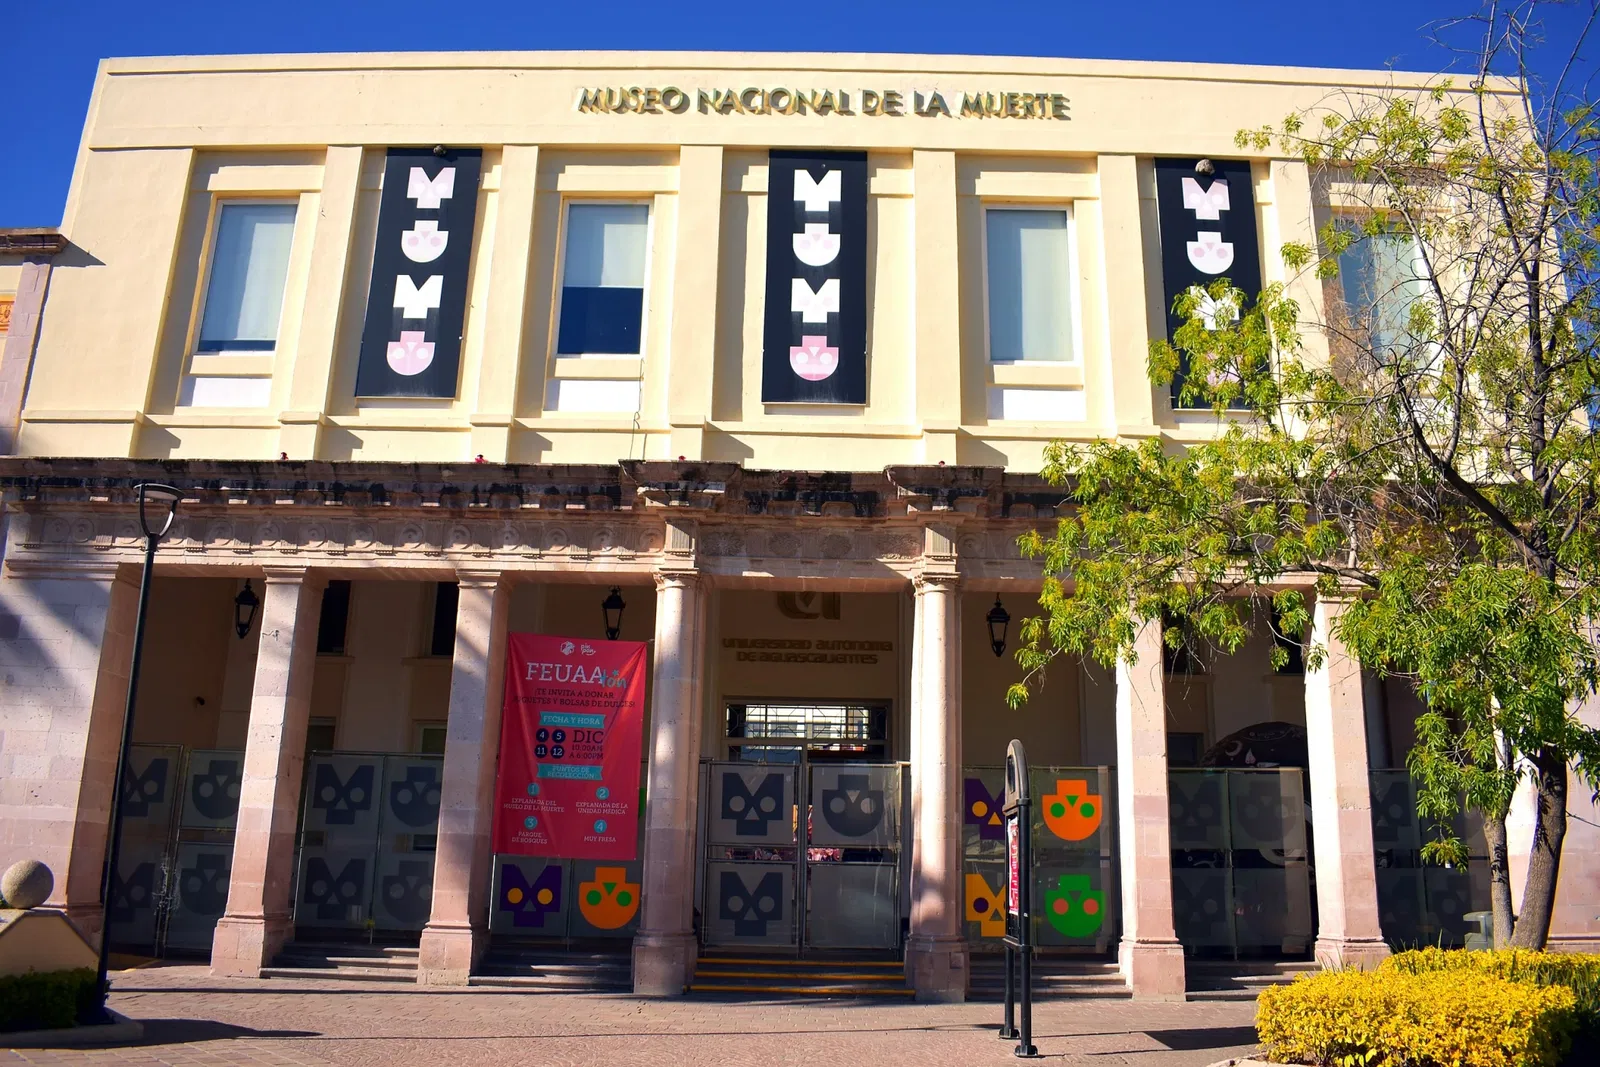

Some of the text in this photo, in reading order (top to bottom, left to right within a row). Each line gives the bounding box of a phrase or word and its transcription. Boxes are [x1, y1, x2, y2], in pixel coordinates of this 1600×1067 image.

[578, 86, 1068, 118] MUSEO NACIONAL DE LA MUERTE
[549, 689, 576, 697] INVITA
[560, 698, 590, 707] BOLSAS
[592, 700, 603, 708] DE
[543, 715, 569, 723] FECHA
[578, 717, 601, 725] HORA
[573, 730, 604, 744] DIC
[536, 747, 563, 756] 11 12
[552, 765, 580, 773] PUNTOS
[511, 797, 545, 805] EXPLANADA
[520, 837, 548, 845] BOSQUES
